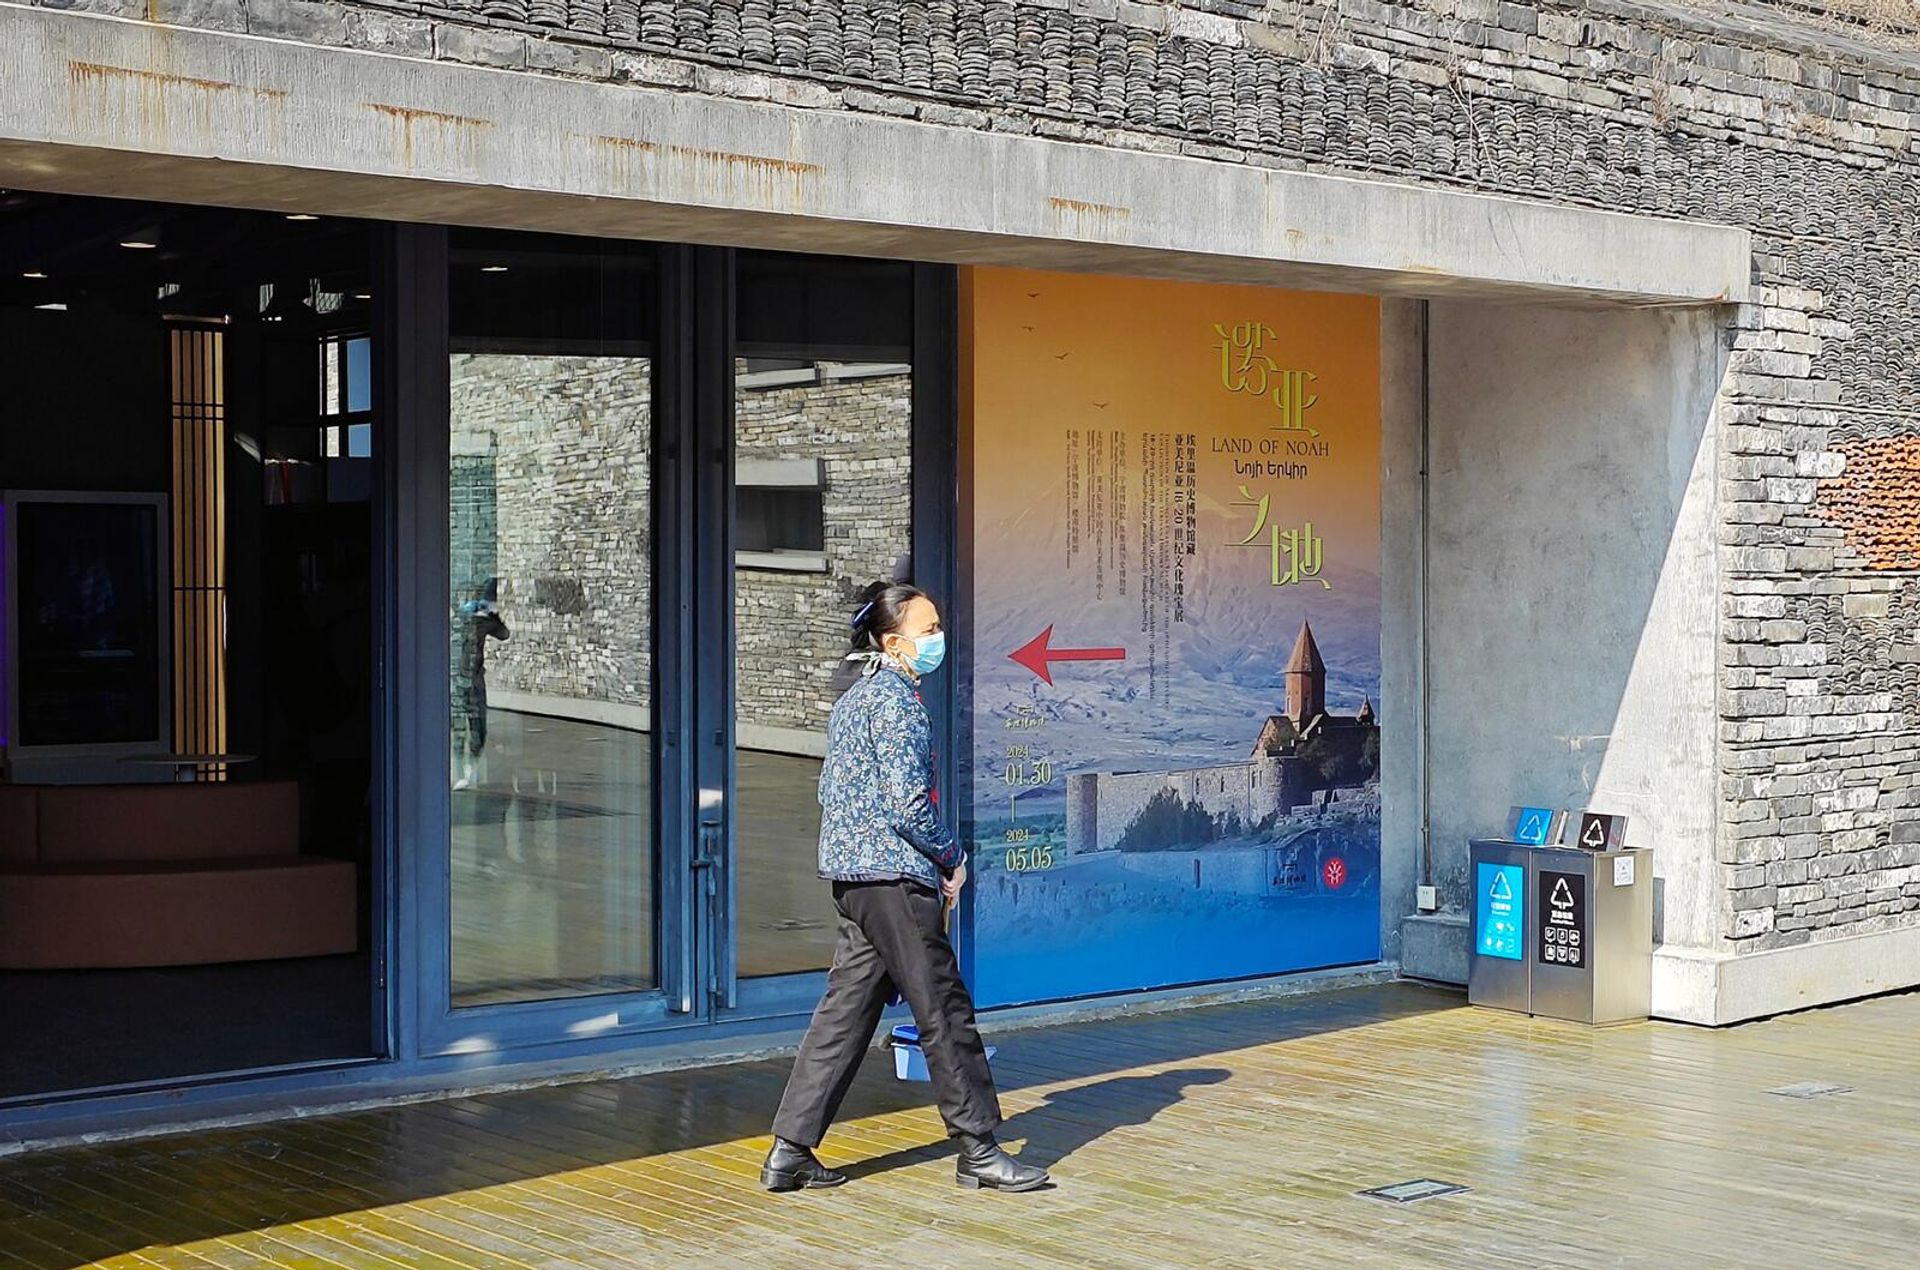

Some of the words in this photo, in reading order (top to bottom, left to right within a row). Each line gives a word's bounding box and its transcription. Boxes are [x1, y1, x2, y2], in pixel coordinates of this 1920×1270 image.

[1212, 437, 1252, 453] LAND
[1259, 439, 1279, 454] OF
[1286, 440, 1329, 456] NOAH
[1186, 434, 1196, 555] 埃里温历史博物馆藏
[1006, 745, 1029, 758] 2024
[1005, 761, 1052, 785] 01.30
[1006, 829, 1029, 842] 2024
[1005, 846, 1053, 871] 05.05
